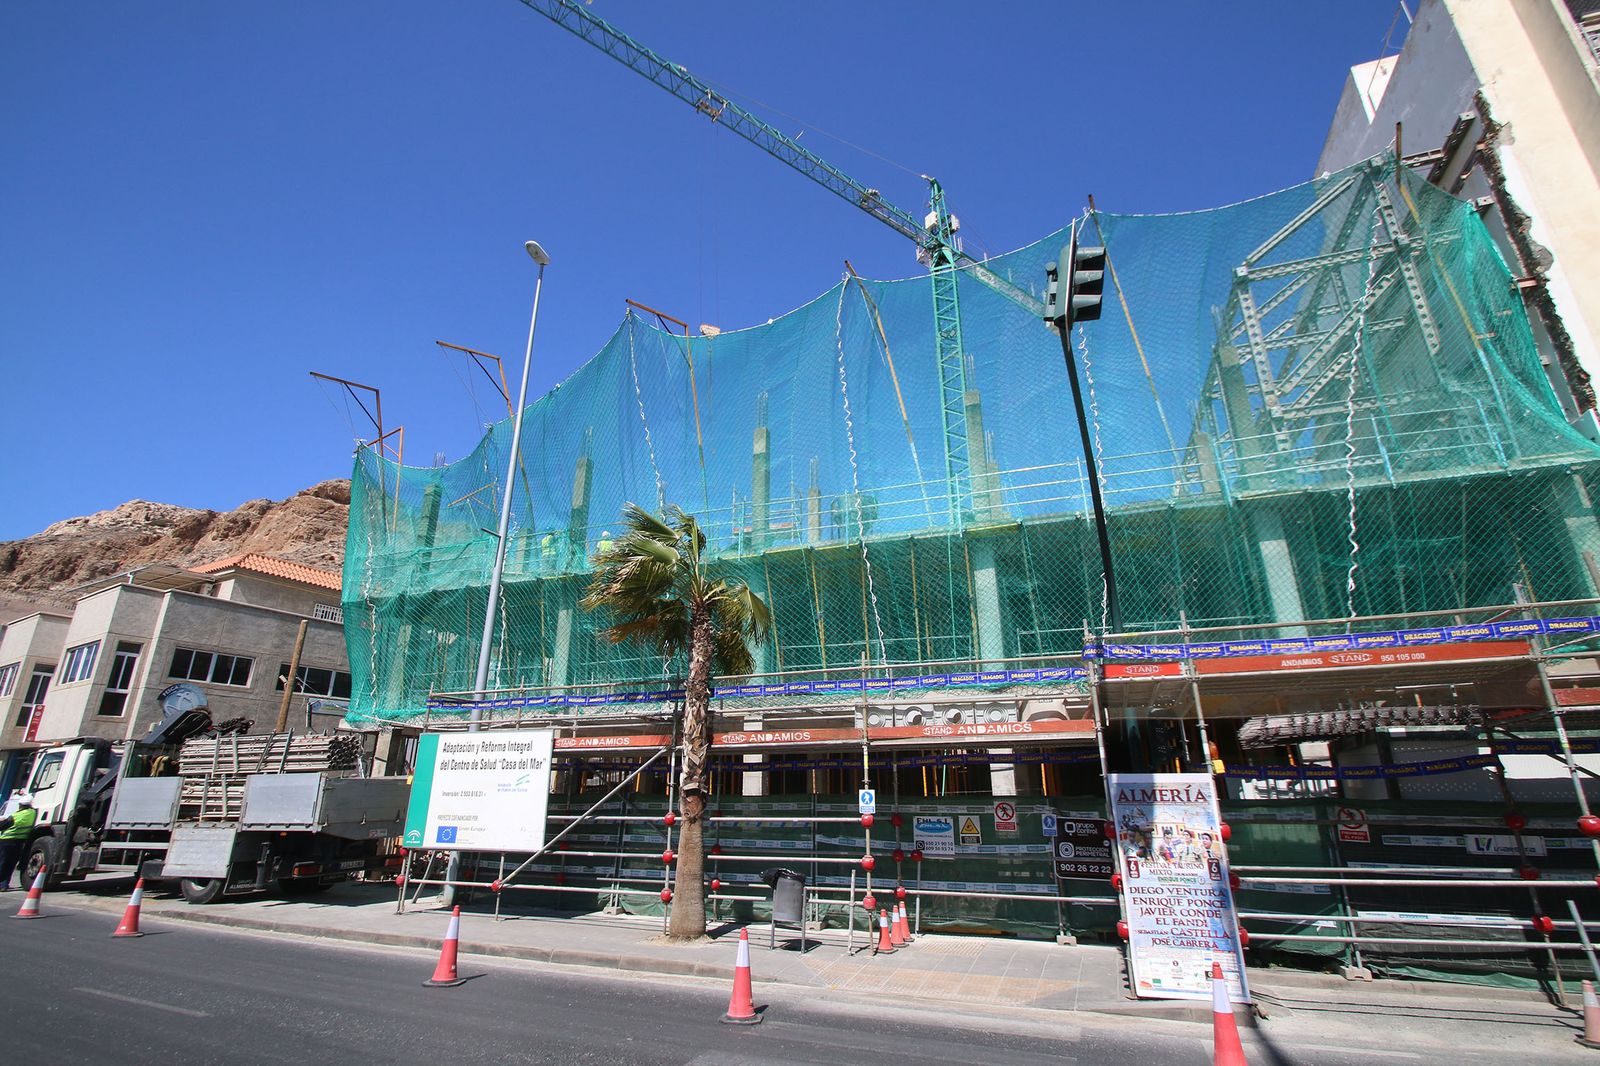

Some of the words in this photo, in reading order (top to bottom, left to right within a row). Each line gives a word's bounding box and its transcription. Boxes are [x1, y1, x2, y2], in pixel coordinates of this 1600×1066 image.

[1281, 658, 1323, 667] ANDAMIOS
[1330, 653, 1371, 662] STAND
[1380, 654, 1395, 662] 950
[1396, 653, 1410, 661] 105
[1411, 652, 1426, 660] 000
[1126, 665, 1160, 673] STAND
[923, 726, 954, 736] STAND
[957, 723, 1033, 734] ANDAMIOS
[578, 737, 631, 746] ANDAMIOS
[749, 731, 811, 742] ANDAMIOS
[443, 742, 476, 755] Adaptación
[481, 741, 507, 753] Reforma
[508, 740, 533, 754] Integral
[440, 759, 450, 771] del
[450, 759, 470, 771] Centro
[471, 759, 479, 770] de
[480, 759, 497, 770] Salud
[518, 758, 529, 770] del
[1118, 784, 1207, 802] ALMERÍA
[1075, 850, 1110, 858] PERIMETRAL
[1060, 863, 1076, 872] 902
[1077, 864, 1088, 872] 26
[1089, 865, 1100, 873] 22
[1101, 866, 1112, 874] 22
[1130, 860, 1136, 871] 6
[1141, 861, 1172, 869] FESTIVAL
[1173, 862, 1204, 870] TAURINO
[1211, 862, 1218, 873] 6
[1149, 868, 1172, 876] MIXTO
[1129, 886, 1164, 895] DIEGO
[1167, 887, 1225, 898] VENTURA
[1132, 897, 1184, 909] ENRIQUE
[1187, 898, 1227, 909] PONCE
[1140, 907, 1177, 918] JAVIER
[1180, 908, 1222, 919] CONDE
[1156, 918, 1170, 926] EL
[1173, 918, 1208, 928] FANDI
[1170, 927, 1231, 940] CASTELLA
[1152, 936, 1171, 947] JOSÉ
[1173, 938, 1219, 949] CABRERA
